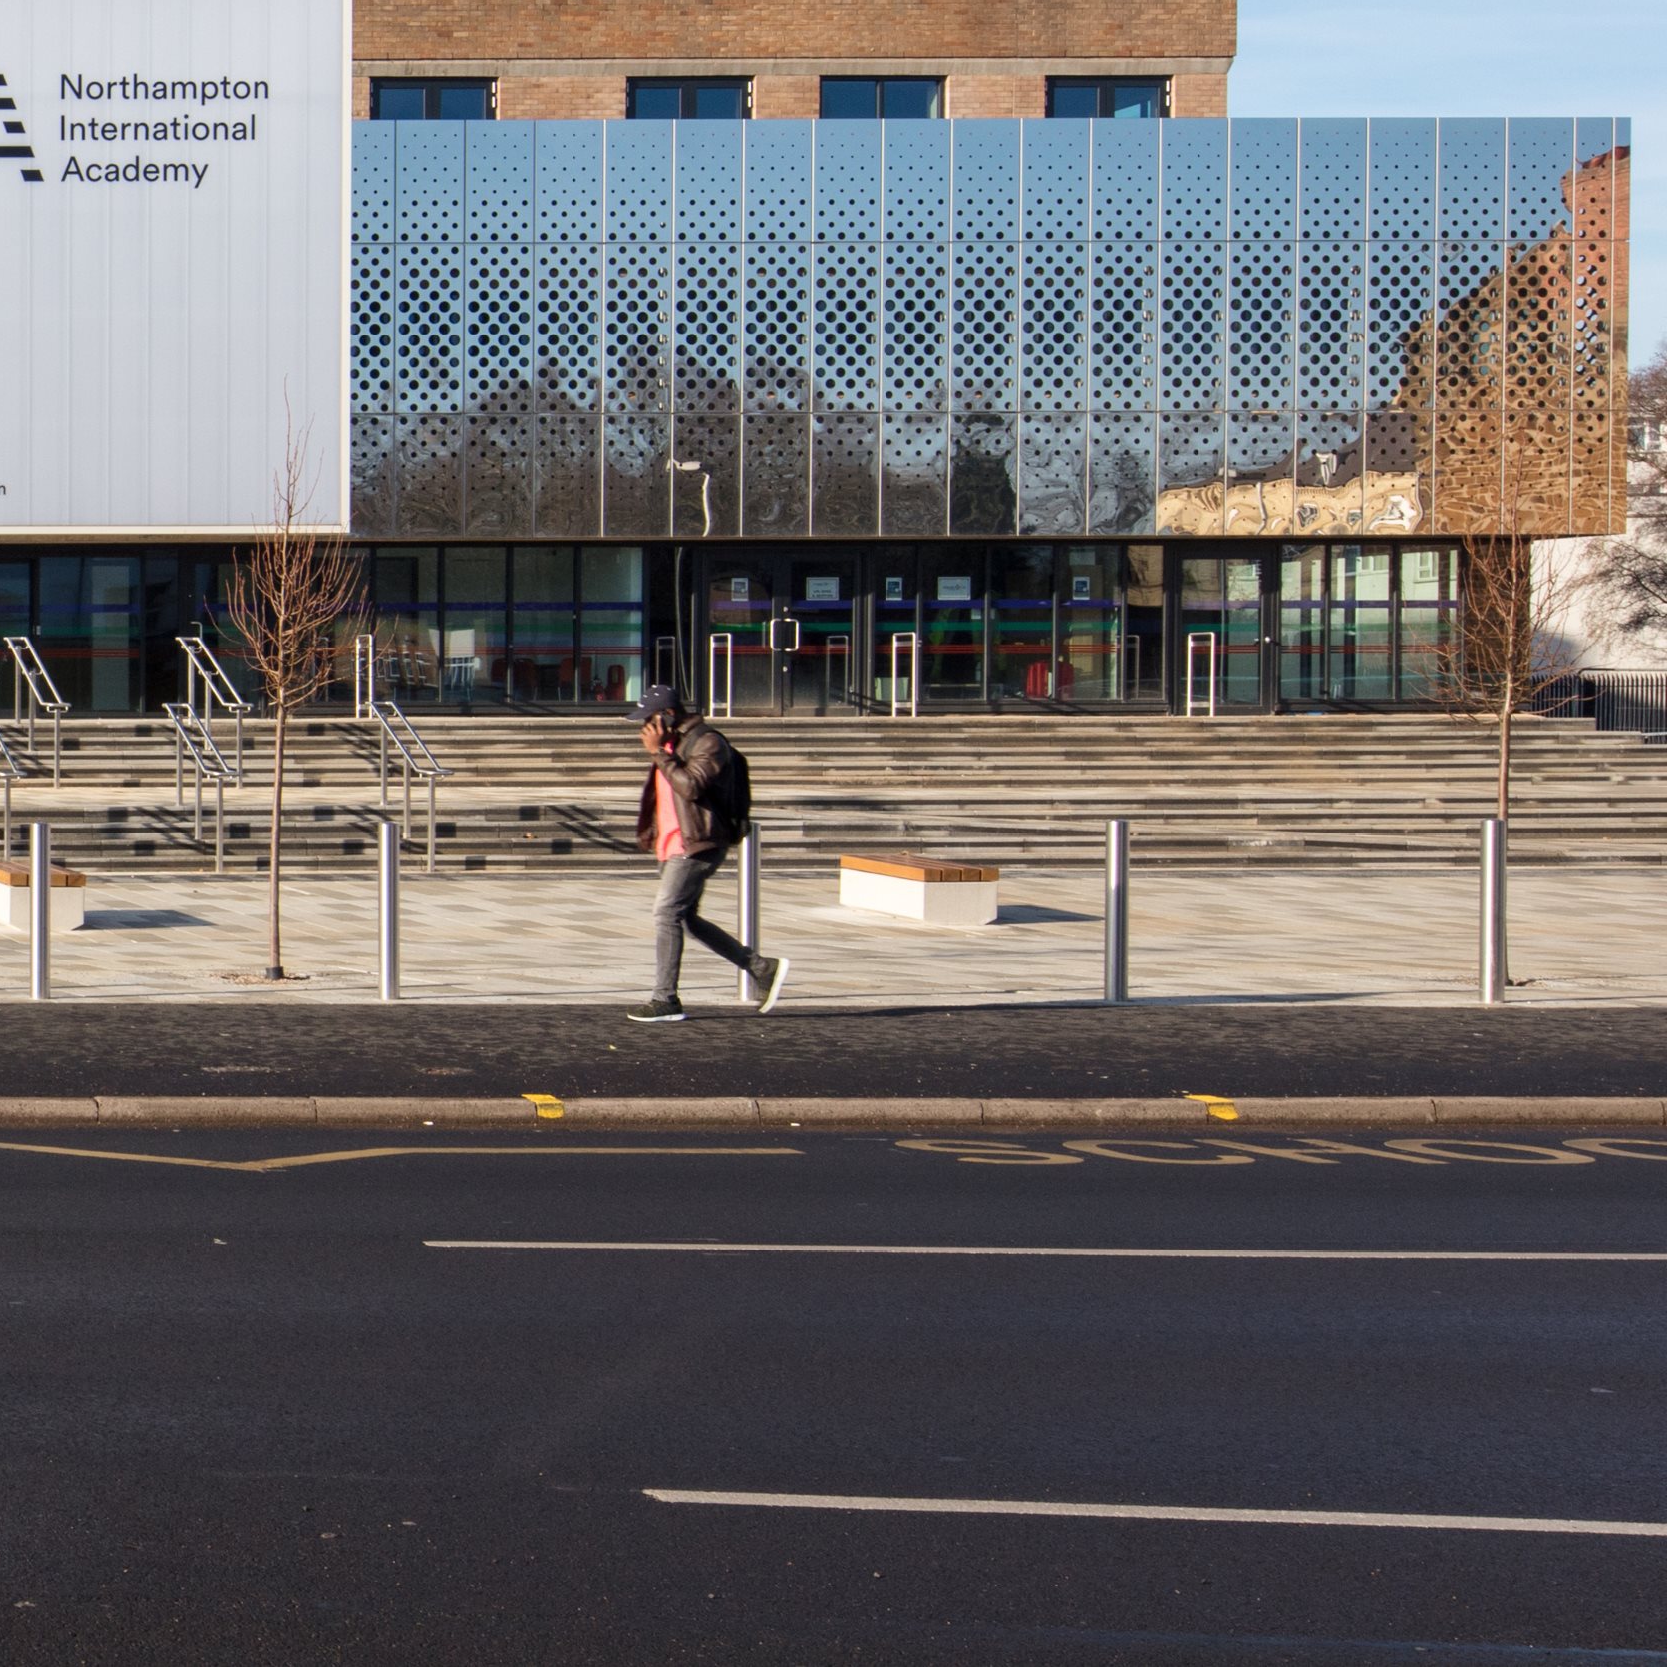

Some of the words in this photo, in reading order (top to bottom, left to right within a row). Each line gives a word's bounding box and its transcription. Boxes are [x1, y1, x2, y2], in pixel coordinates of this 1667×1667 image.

[60, 73, 269, 105] Northampton
[60, 113, 256, 142] International
[60, 155, 209, 189] Academy
